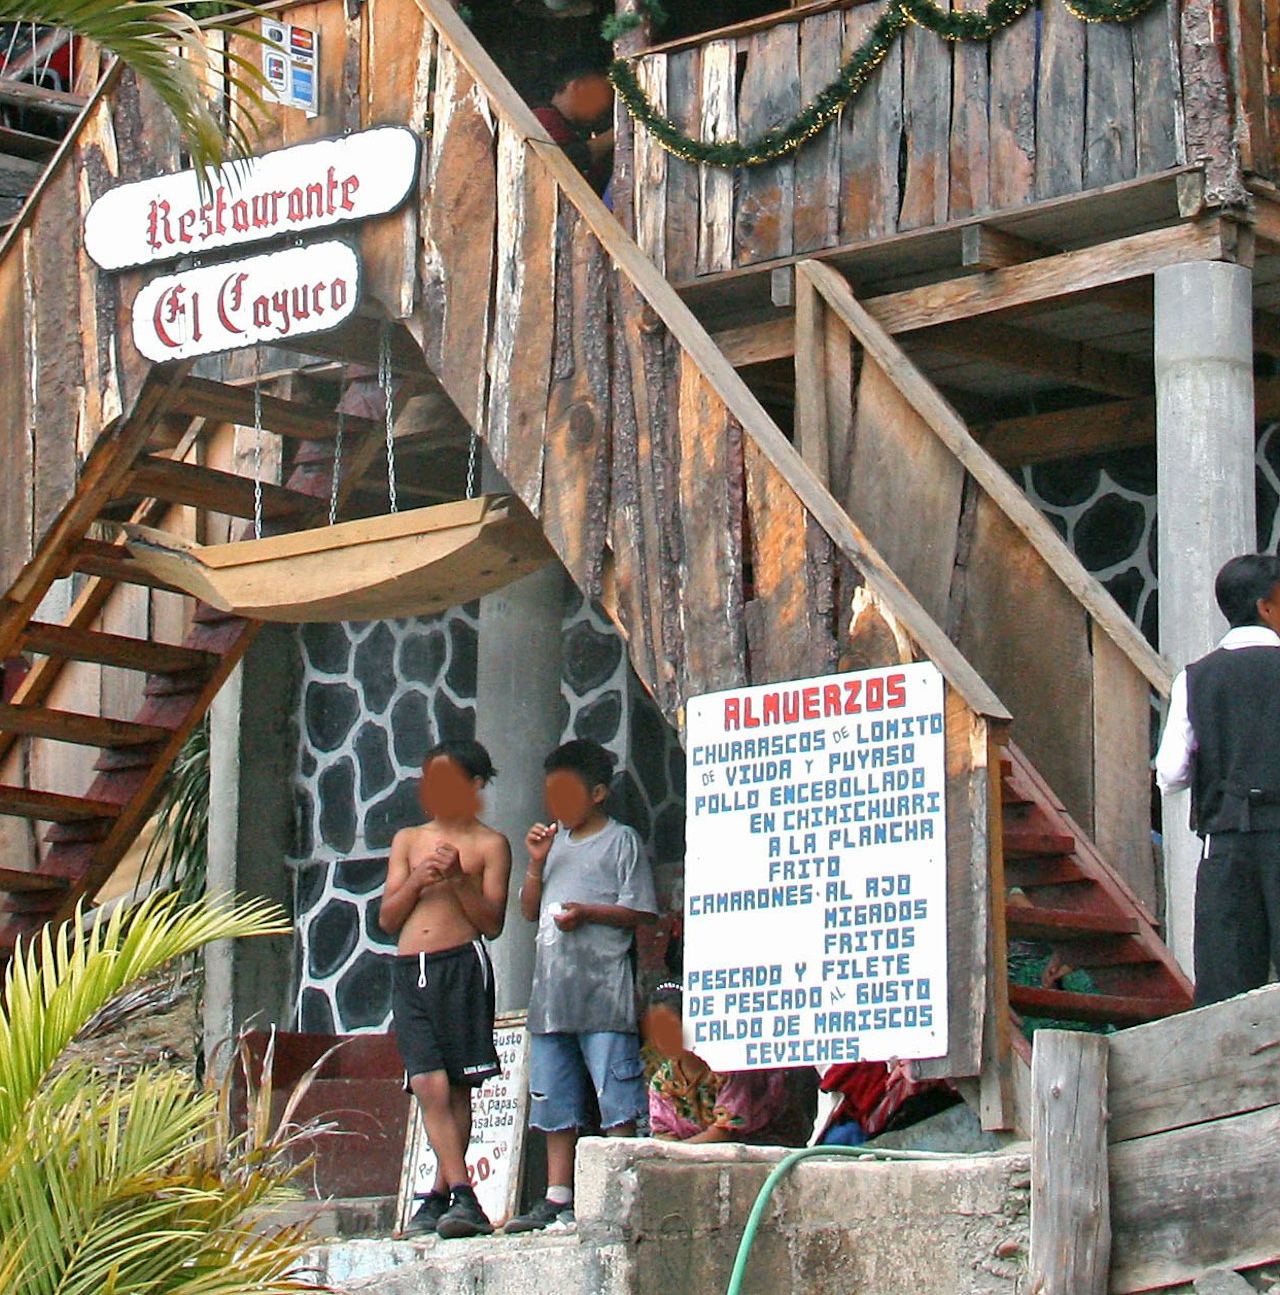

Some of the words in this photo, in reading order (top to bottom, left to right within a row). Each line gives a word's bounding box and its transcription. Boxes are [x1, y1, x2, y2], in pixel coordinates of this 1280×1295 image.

[146, 165, 360, 253] Restaurante
[153, 283, 203, 347] El
[218, 272, 347, 334] Cayuco
[724, 674, 906, 731] ALMUERZOS
[692, 729, 826, 766] CHURRASCOS
[832, 726, 850, 743] DE
[856, 713, 942, 744] LOMITO
[702, 770, 715, 786] DE
[726, 759, 791, 786] VIUDA
[804, 759, 814, 773] Y
[829, 743, 915, 773] PUYASO
[695, 790, 759, 816] POLLO
[770, 767, 925, 806] ENCEBOLLADO
[750, 813, 775, 833] EN
[783, 792, 940, 830] CHIMICHURRI
[768, 837, 781, 857] A
[789, 833, 816, 855] LA
[828, 819, 934, 850] PLANCHA
[769, 856, 840, 882] FRITO
[689, 884, 813, 916] CAMARONES
[825, 880, 853, 902] AL
[866, 874, 911, 898] AJO
[824, 899, 928, 928] MIGADOS
[824, 927, 915, 954] FRITOS
[688, 964, 782, 991] PESCADO
[794, 962, 807, 982] Y
[822, 953, 910, 981] FILETE
[689, 996, 714, 1017] DE
[724, 986, 822, 1014] PESCADO
[830, 986, 846, 1005] AL
[856, 978, 930, 1005] GUSTO
[695, 1017, 763, 1042] CALDO
[773, 1015, 800, 1037] DE
[814, 1005, 933, 1034] MARISCOS
[746, 1037, 860, 1065] CEVICHES
[471, 1085, 507, 1099] omito
[471, 1112, 513, 1130] nsalada
